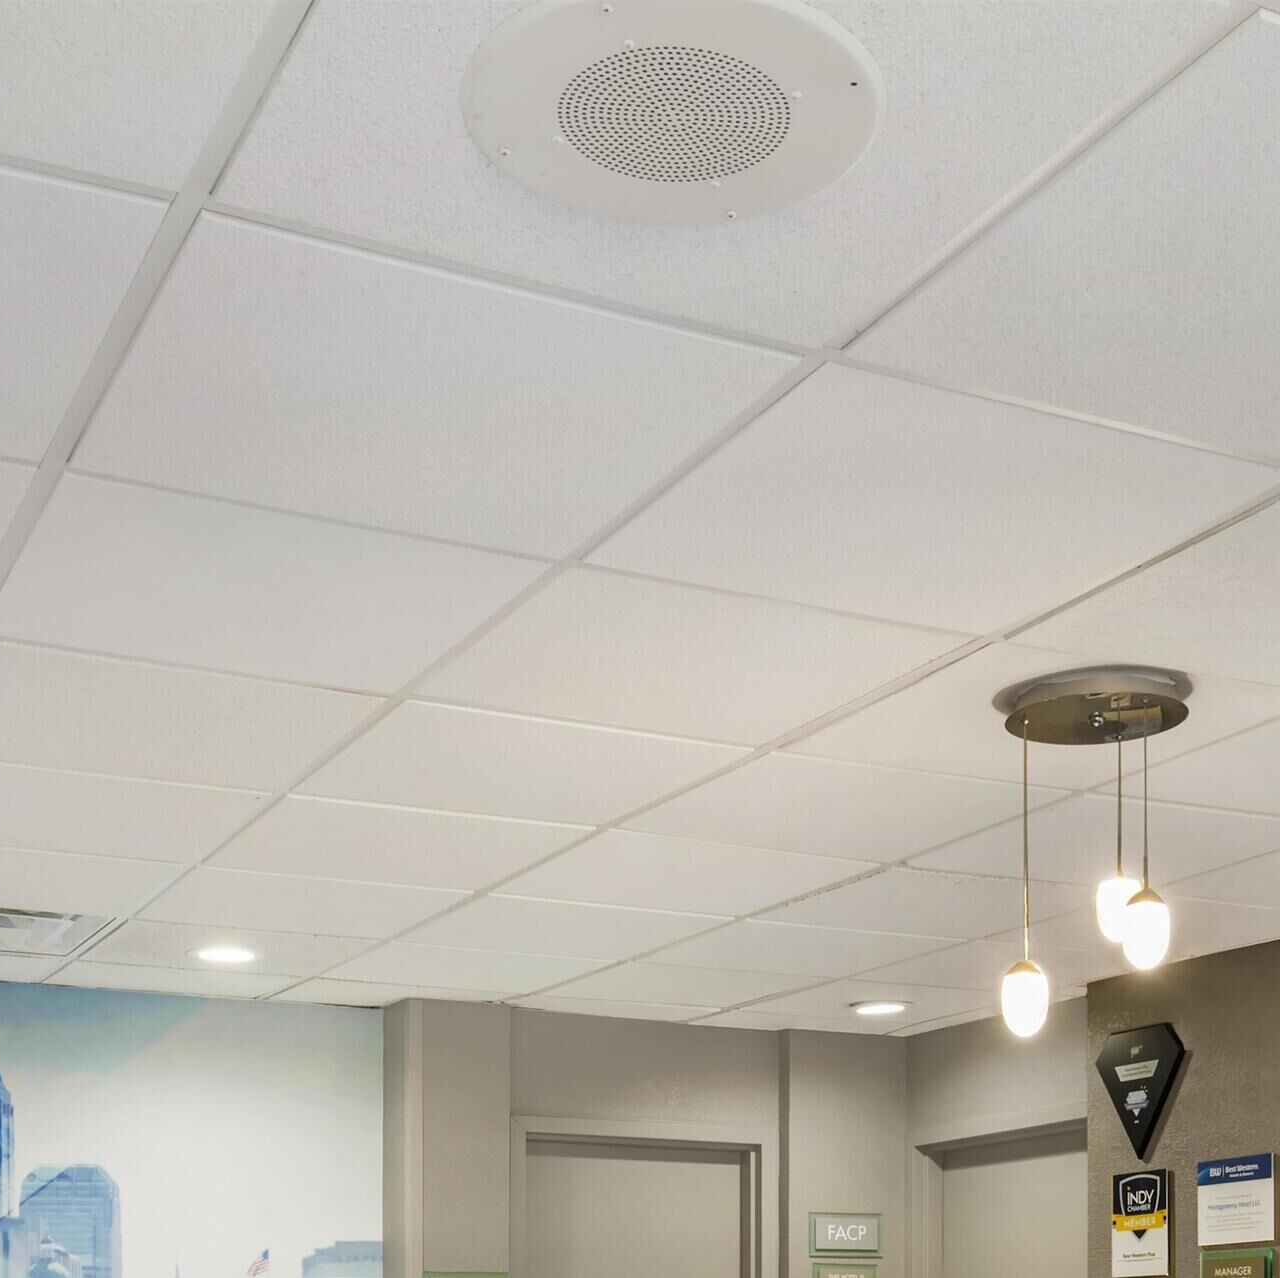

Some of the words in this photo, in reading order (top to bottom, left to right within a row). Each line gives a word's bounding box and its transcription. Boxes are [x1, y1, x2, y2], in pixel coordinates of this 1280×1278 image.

[1124, 1216, 1156, 1228] MEMBER
[828, 1224, 867, 1240] FACP
[1215, 1266, 1252, 1277] MANAGER
